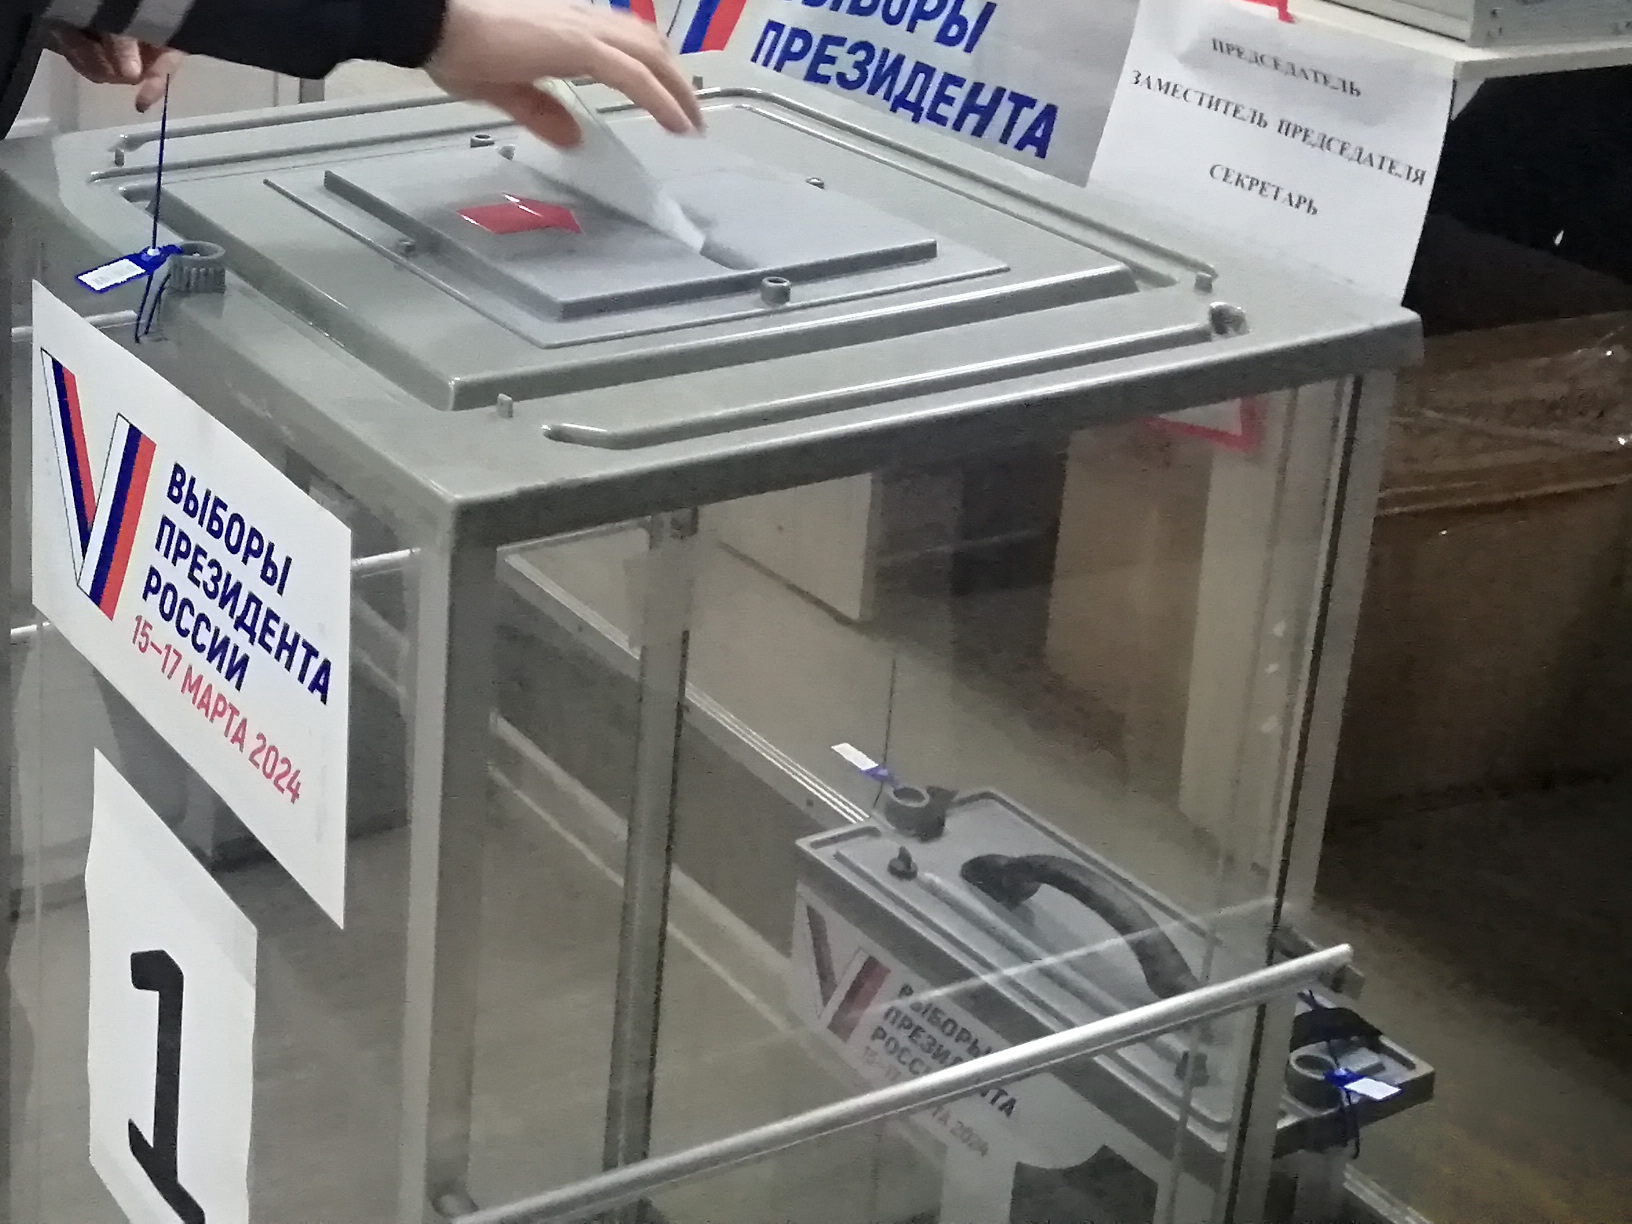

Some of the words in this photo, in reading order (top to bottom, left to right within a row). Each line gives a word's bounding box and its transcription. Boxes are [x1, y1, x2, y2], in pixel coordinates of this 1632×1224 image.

[750, 19, 1059, 159] ПРЕЗИДЕНТА
[1132, 70, 1268, 128] ЗАМЕСТИТЕЛЬ
[1277, 118, 1427, 186] ПРЕДСЕДАТЕЛЯ
[1212, 37, 1361, 97] ПРЕДСЕДАТЕЛЬ
[1209, 164, 1318, 215] СЕКРЕТАРЬ
[167, 462, 293, 597] ВЫБОРЫ
[142, 565, 250, 692] РОССИИ
[155, 514, 332, 705] ПРЕЗИДЕНТА
[180, 664, 248, 752] МАРТА
[248, 732, 303, 805] 2024
[128, 949, 206, 1224] 1
[871, 1025, 932, 1075] РОСС
